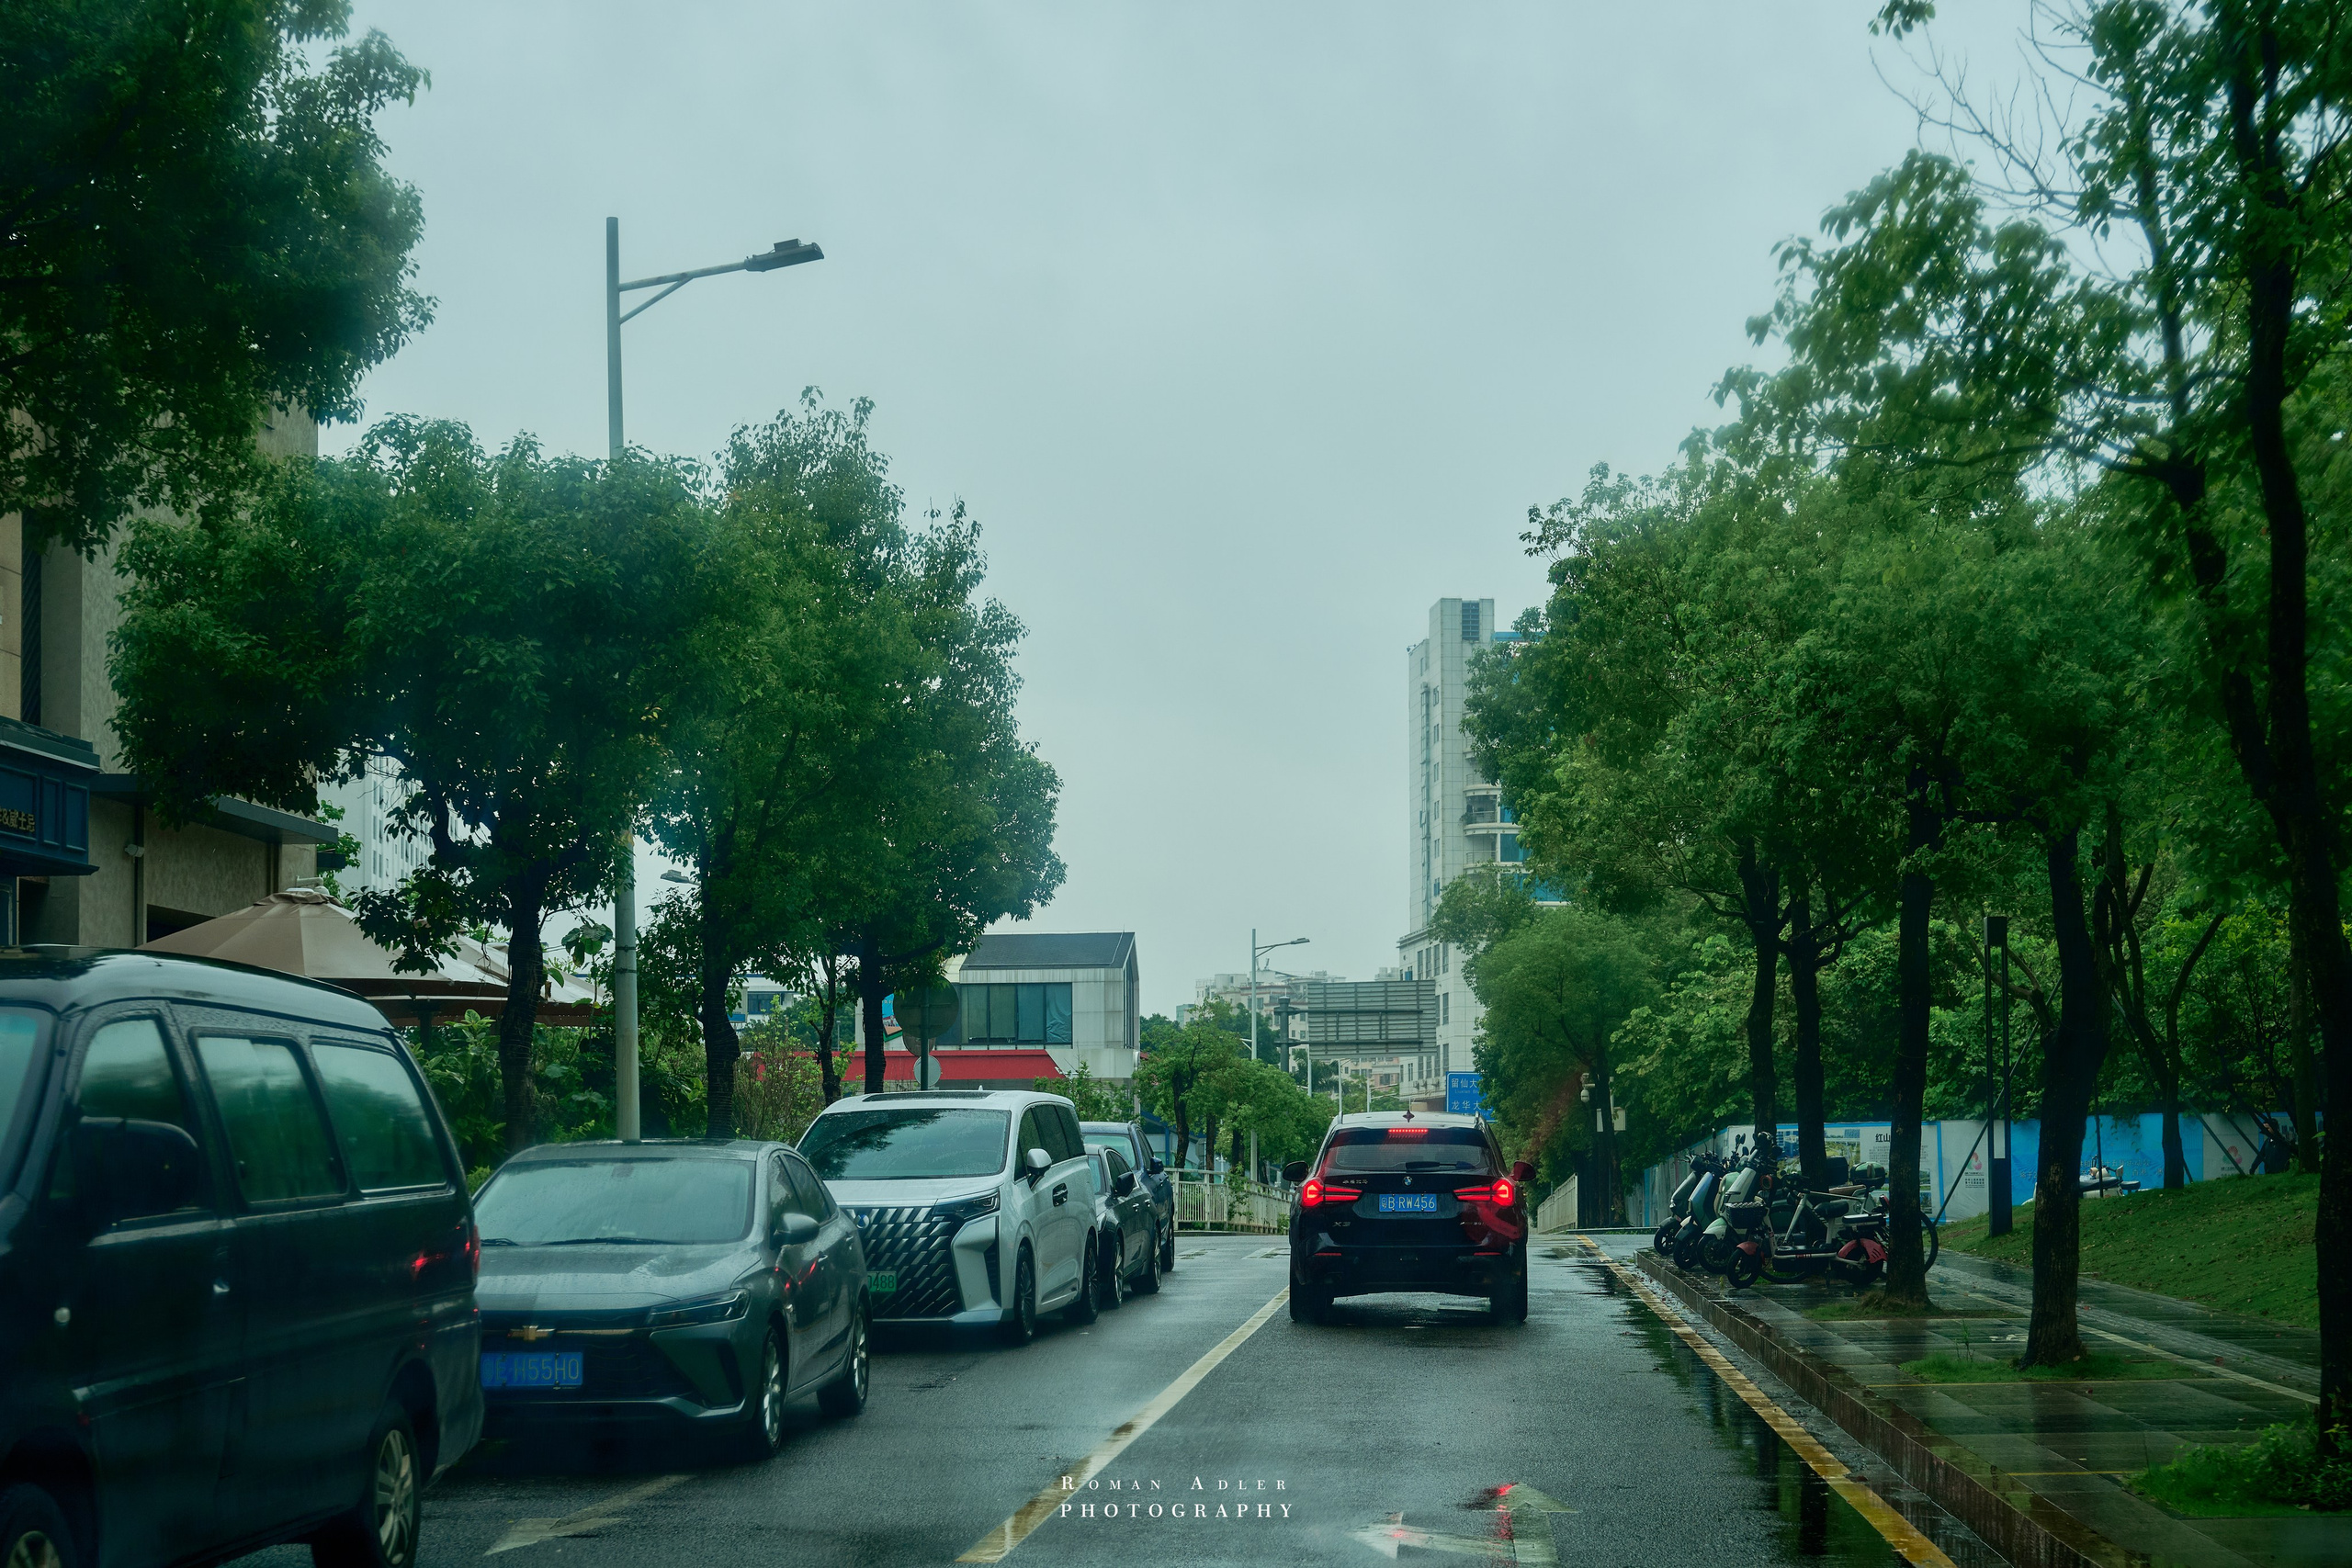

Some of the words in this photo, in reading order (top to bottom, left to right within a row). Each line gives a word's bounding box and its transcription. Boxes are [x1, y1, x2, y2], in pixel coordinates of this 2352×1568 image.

[1451, 1077, 1480, 1089] 留仙大
[1452, 1100, 1492, 1111] 龙华大
